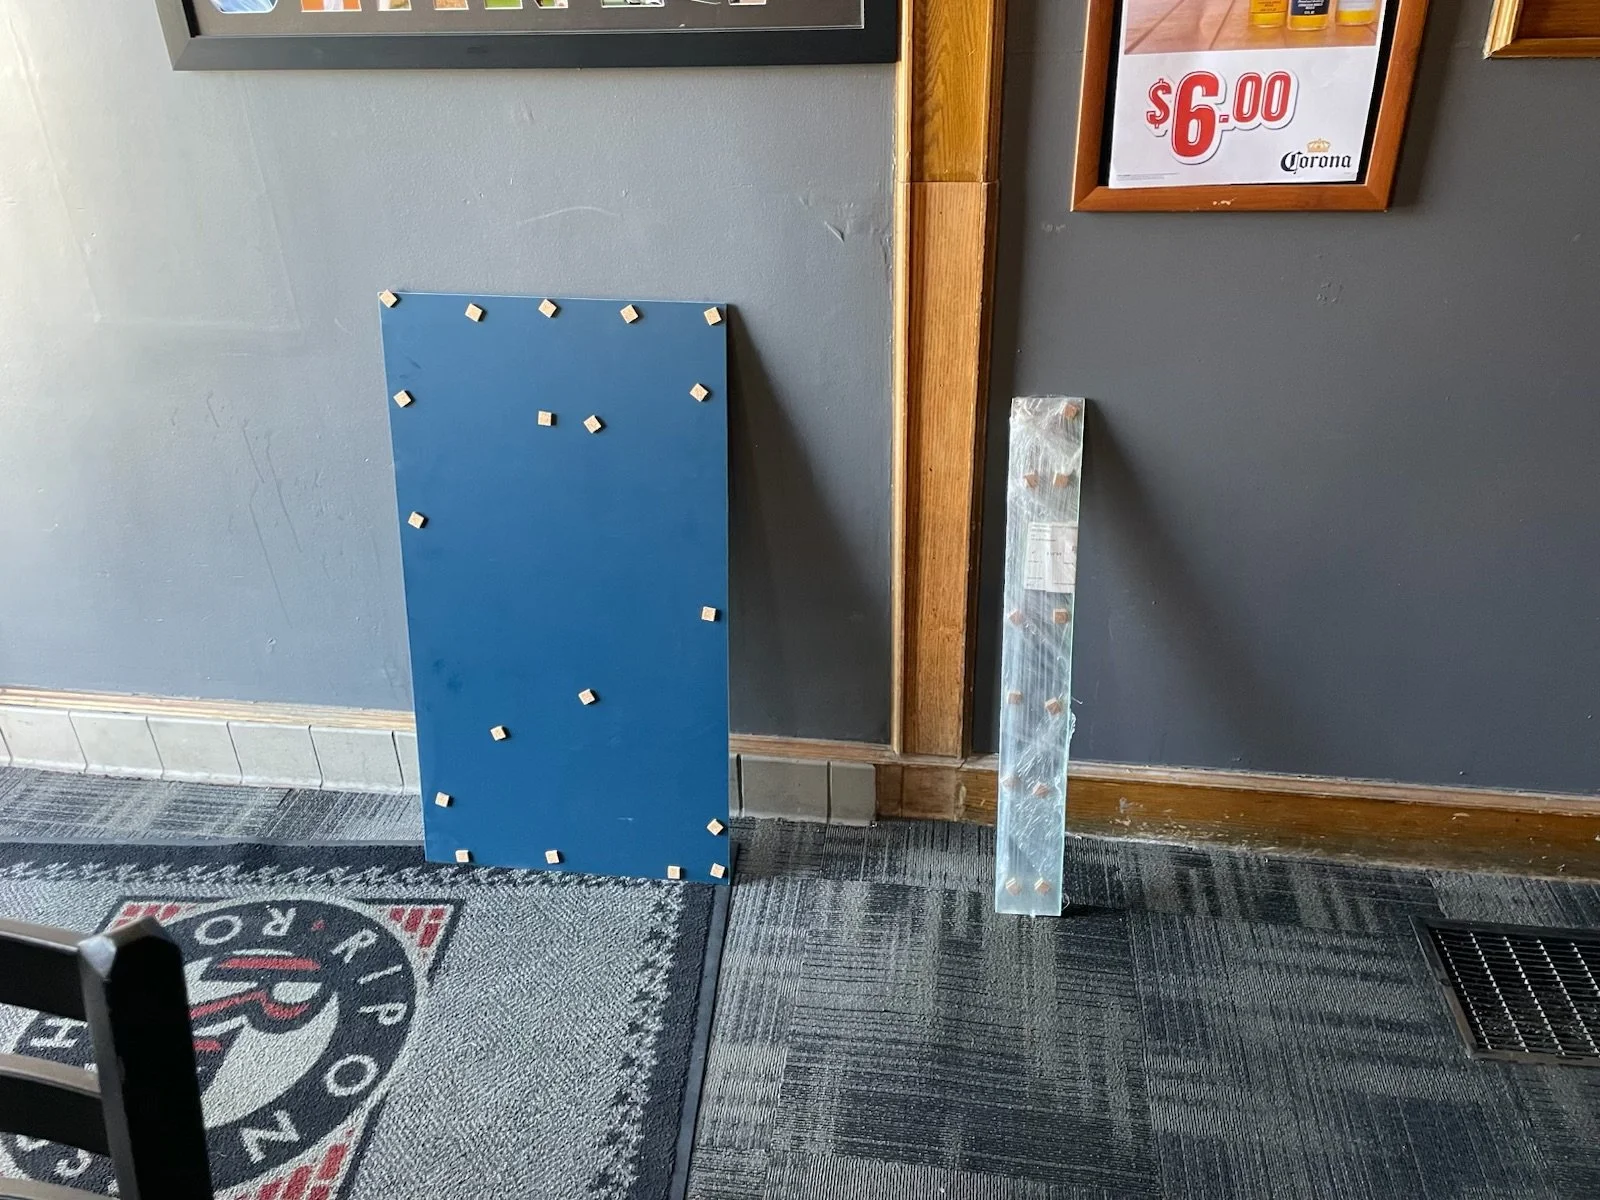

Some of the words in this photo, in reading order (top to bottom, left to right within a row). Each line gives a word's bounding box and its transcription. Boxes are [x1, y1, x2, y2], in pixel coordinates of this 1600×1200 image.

[1147, 71, 1291, 158] $6.00
[1281, 151, 1352, 174] Corona
[240, 929, 406, 1165] RIPON
